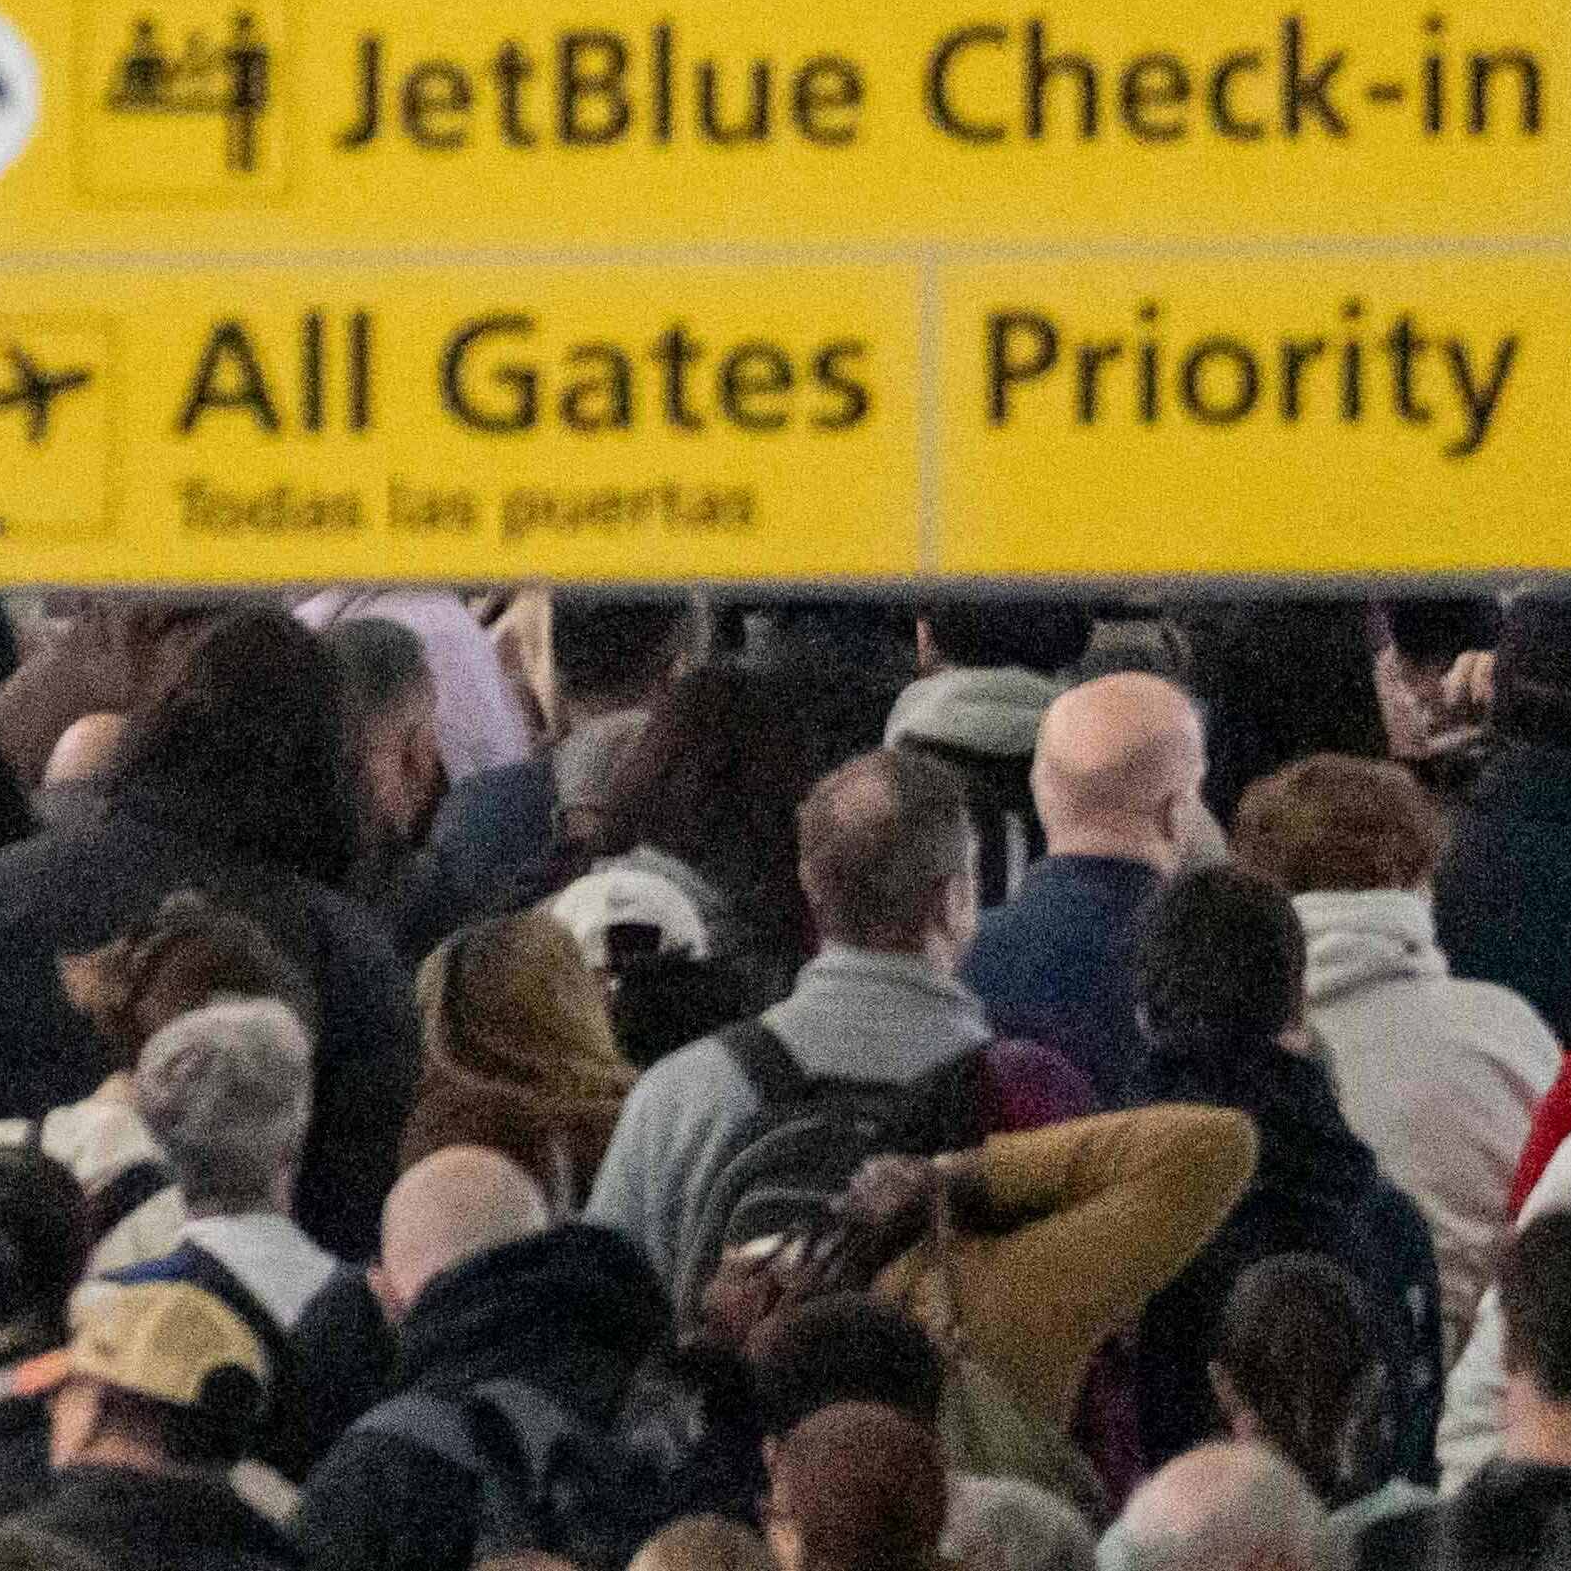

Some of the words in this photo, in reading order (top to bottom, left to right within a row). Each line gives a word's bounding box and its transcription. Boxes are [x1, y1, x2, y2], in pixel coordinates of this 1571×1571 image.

[337, 21, 866, 152] JetBlue
[923, 15, 1544, 145] Check-in
[174, 311, 373, 436] All
[438, 314, 872, 436] Gates
[986, 300, 1520, 461] Priority
[179, 479, 364, 534] Todas
[388, 483, 479, 532] las
[501, 482, 757, 541] puertas
